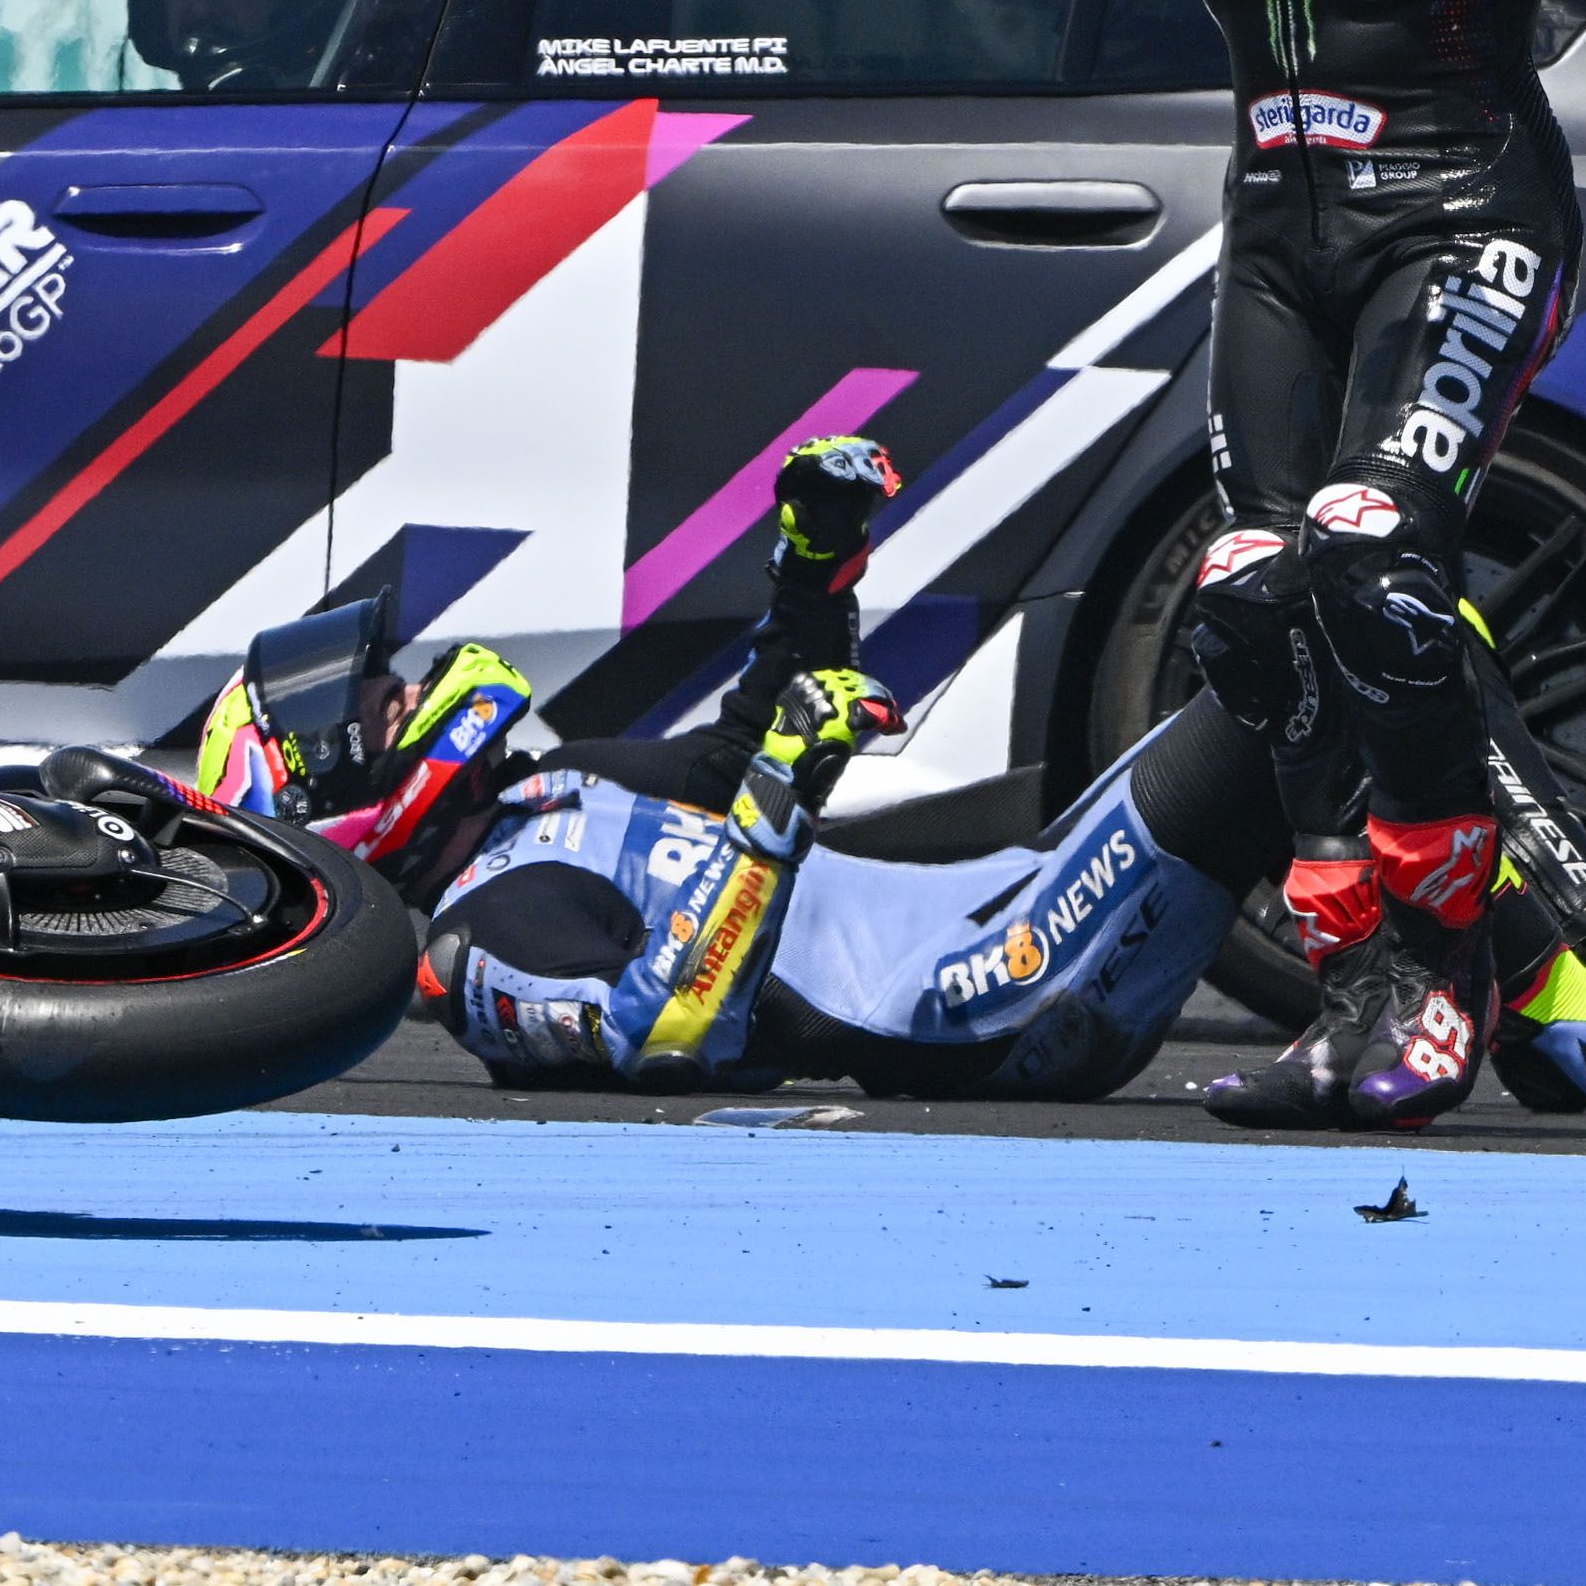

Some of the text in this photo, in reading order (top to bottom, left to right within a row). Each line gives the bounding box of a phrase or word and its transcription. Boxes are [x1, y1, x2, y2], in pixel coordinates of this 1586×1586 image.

[537, 37, 612, 55] MIKE
[614, 36, 750, 55] LAFUENTE
[627, 55, 733, 75] CHARTE
[733, 56, 790, 74] M.D.
[1380, 170, 1418, 181] GROUP
[1400, 236, 1542, 474] aprilia
[687, 842, 738, 914] NEWS
[939, 828, 1136, 1009] BK8 NEWS
[1405, 989, 1474, 1085] 89
